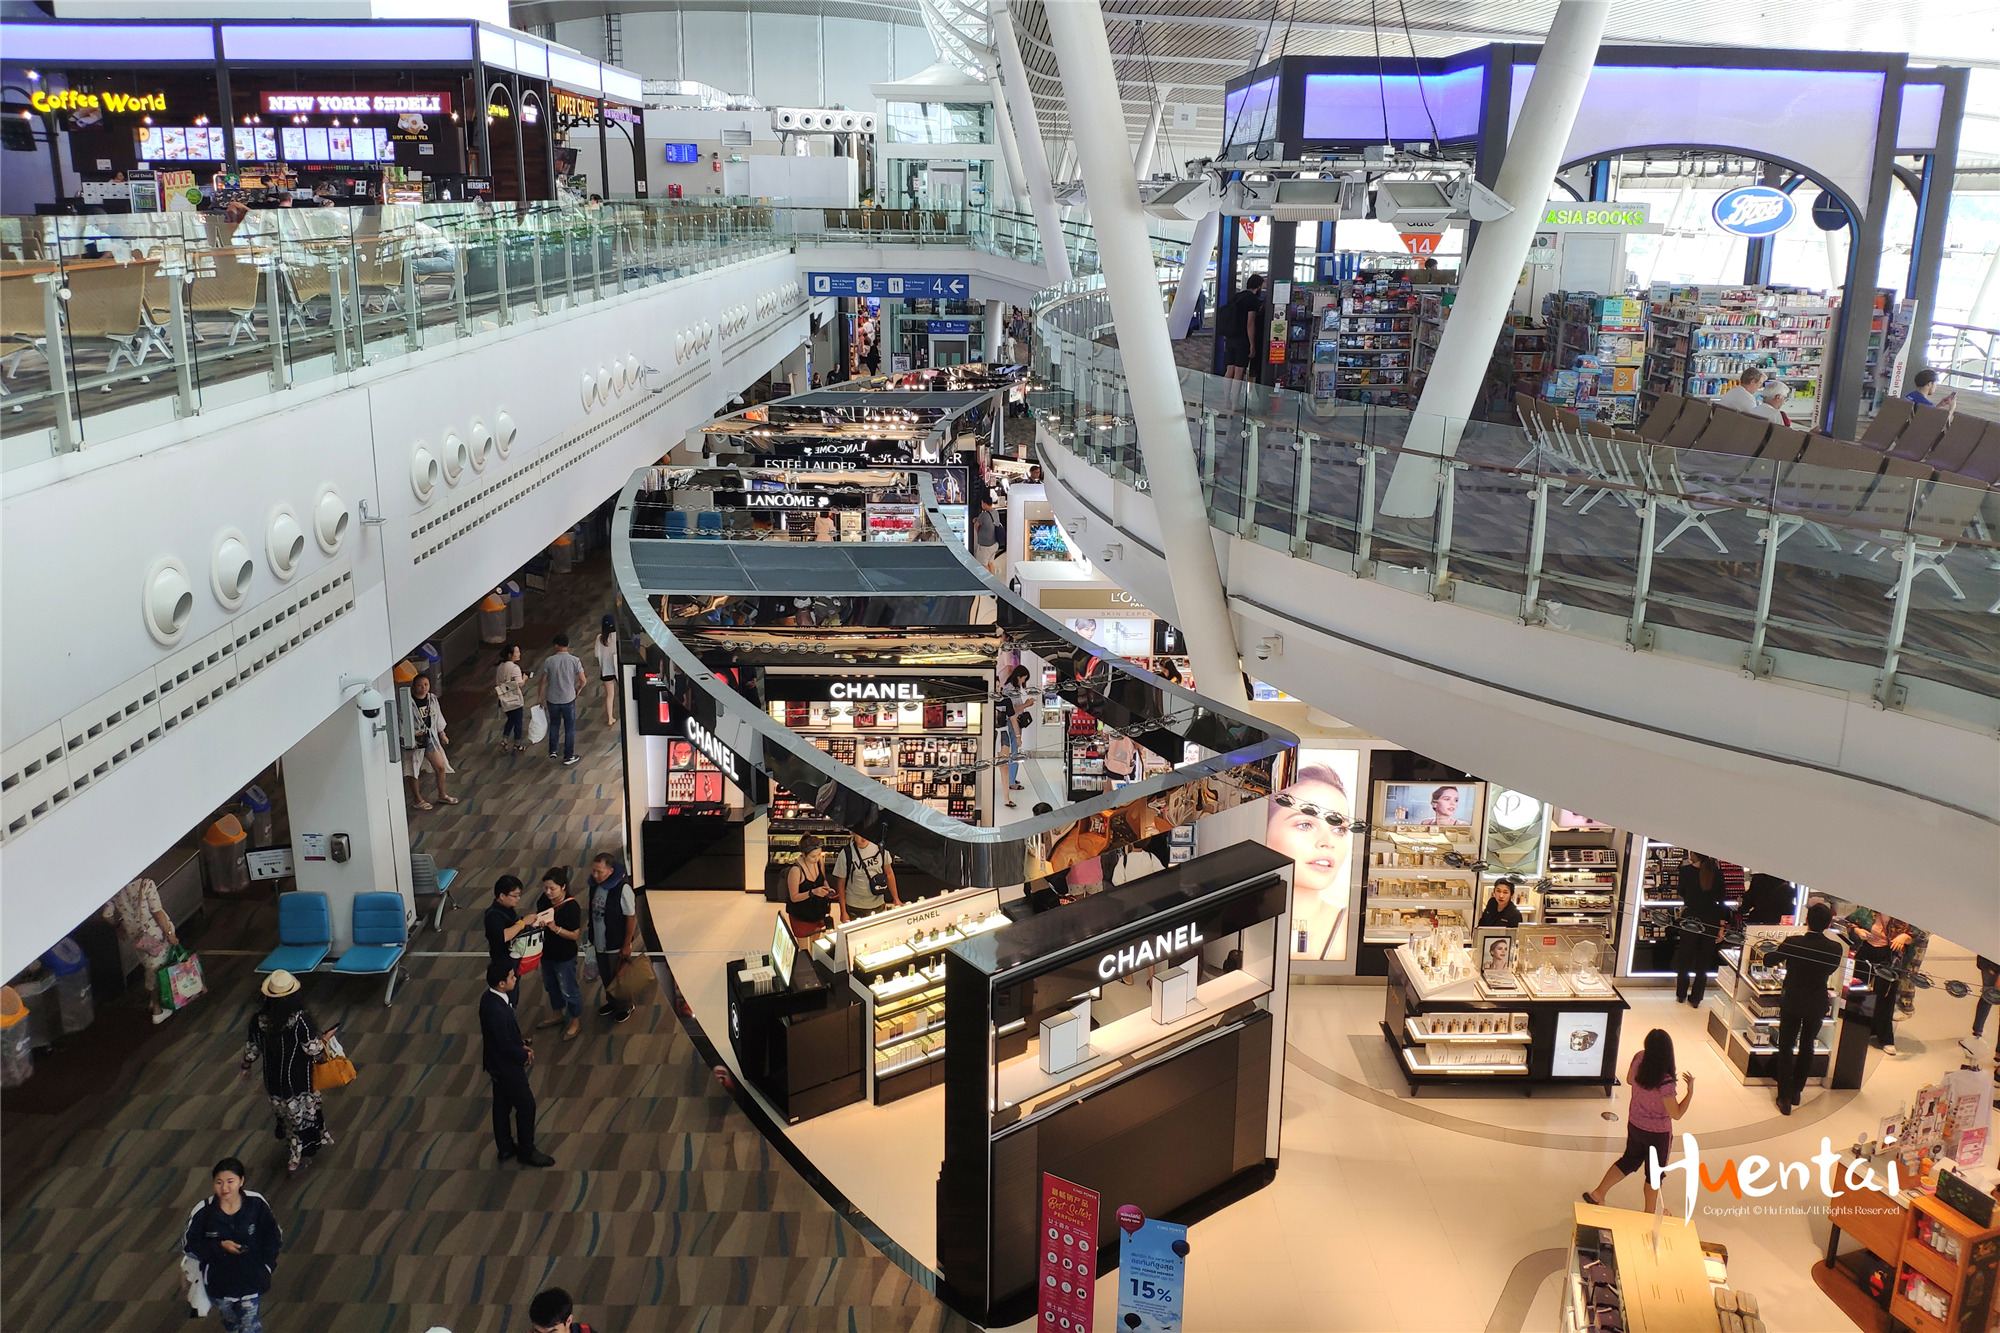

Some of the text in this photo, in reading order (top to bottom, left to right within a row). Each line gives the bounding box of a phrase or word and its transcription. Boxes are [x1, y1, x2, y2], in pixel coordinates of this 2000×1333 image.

[31, 90, 167, 113] Coffee World
[268, 96, 315, 111] NEW
[316, 96, 372, 111] YORK
[556, 94, 577, 116] UPPER
[577, 99, 595, 119] CRUST
[164, 171, 192, 187] WTF
[1545, 210, 1644, 226] ASIA BOOKS
[1722, 194, 1785, 227] Boots
[1242, 221, 1255, 235] 15
[1407, 238, 1432, 254] 14
[932, 278, 943, 295] 4
[947, 380, 966, 391] Dior
[746, 494, 815, 507] LANCÔME
[1111, 591, 1137, 603] L'O
[830, 682, 925, 699] CHANEL
[686, 716, 740, 781] CHANEL
[906, 910, 941, 926] CHANEL
[1098, 921, 1204, 979] CHANEL
[1047, 1196, 1092, 1221] Best Sellers
[1053, 1211, 1085, 1227] PERFUMES
[1129, 1278, 1173, 1303] 15%
